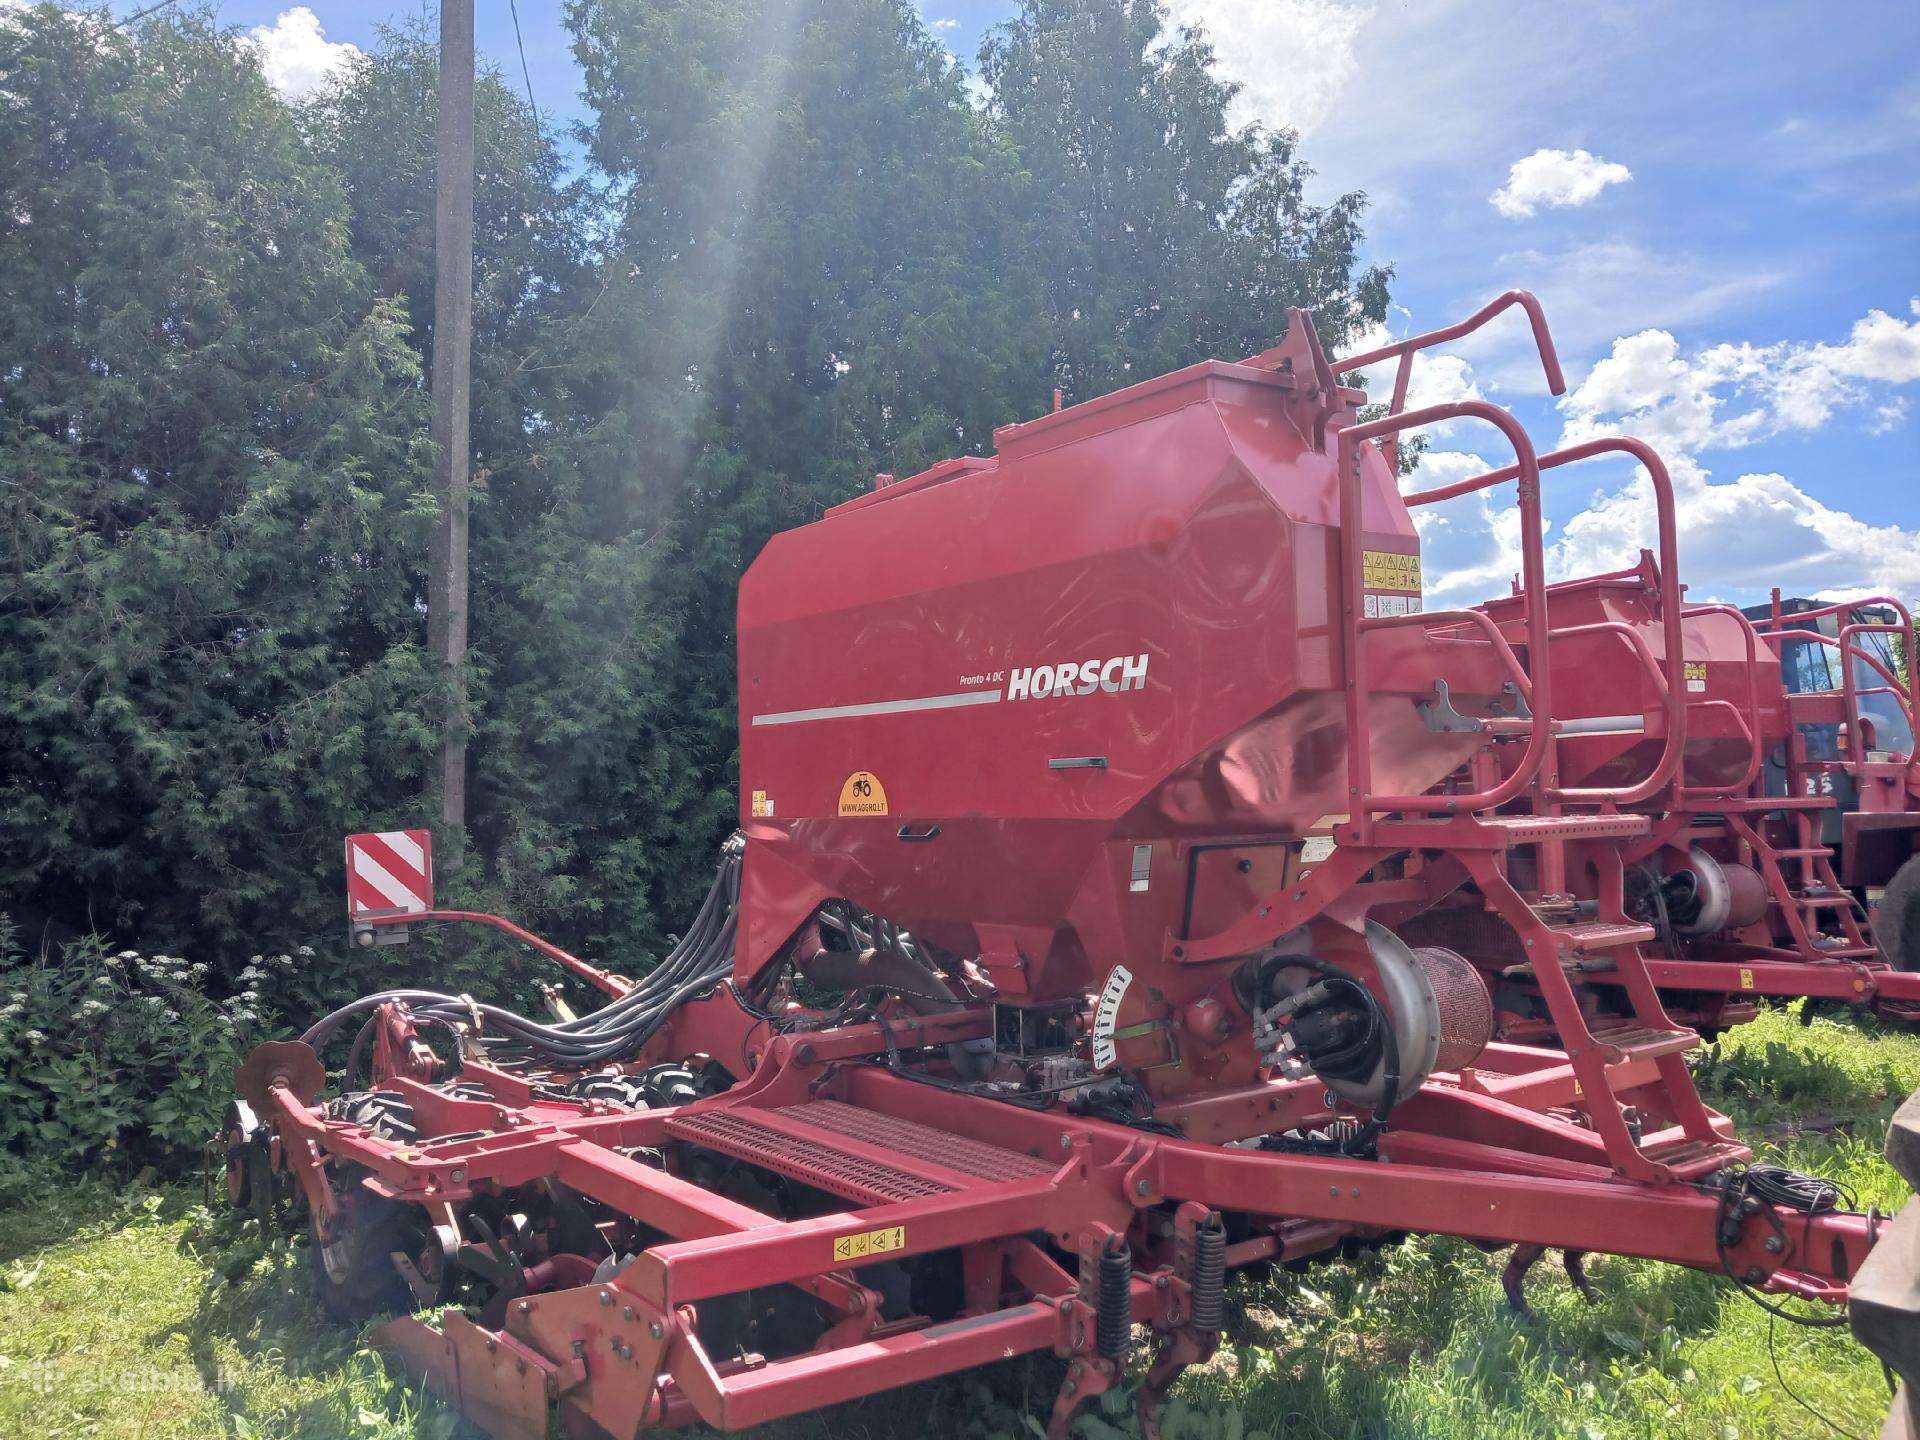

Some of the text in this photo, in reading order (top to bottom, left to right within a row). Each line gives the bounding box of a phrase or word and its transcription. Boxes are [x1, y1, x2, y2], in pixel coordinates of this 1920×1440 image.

[959, 674, 985, 686] Pronto
[992, 670, 1005, 682] DC
[1007, 653, 1149, 701] HORSCH
